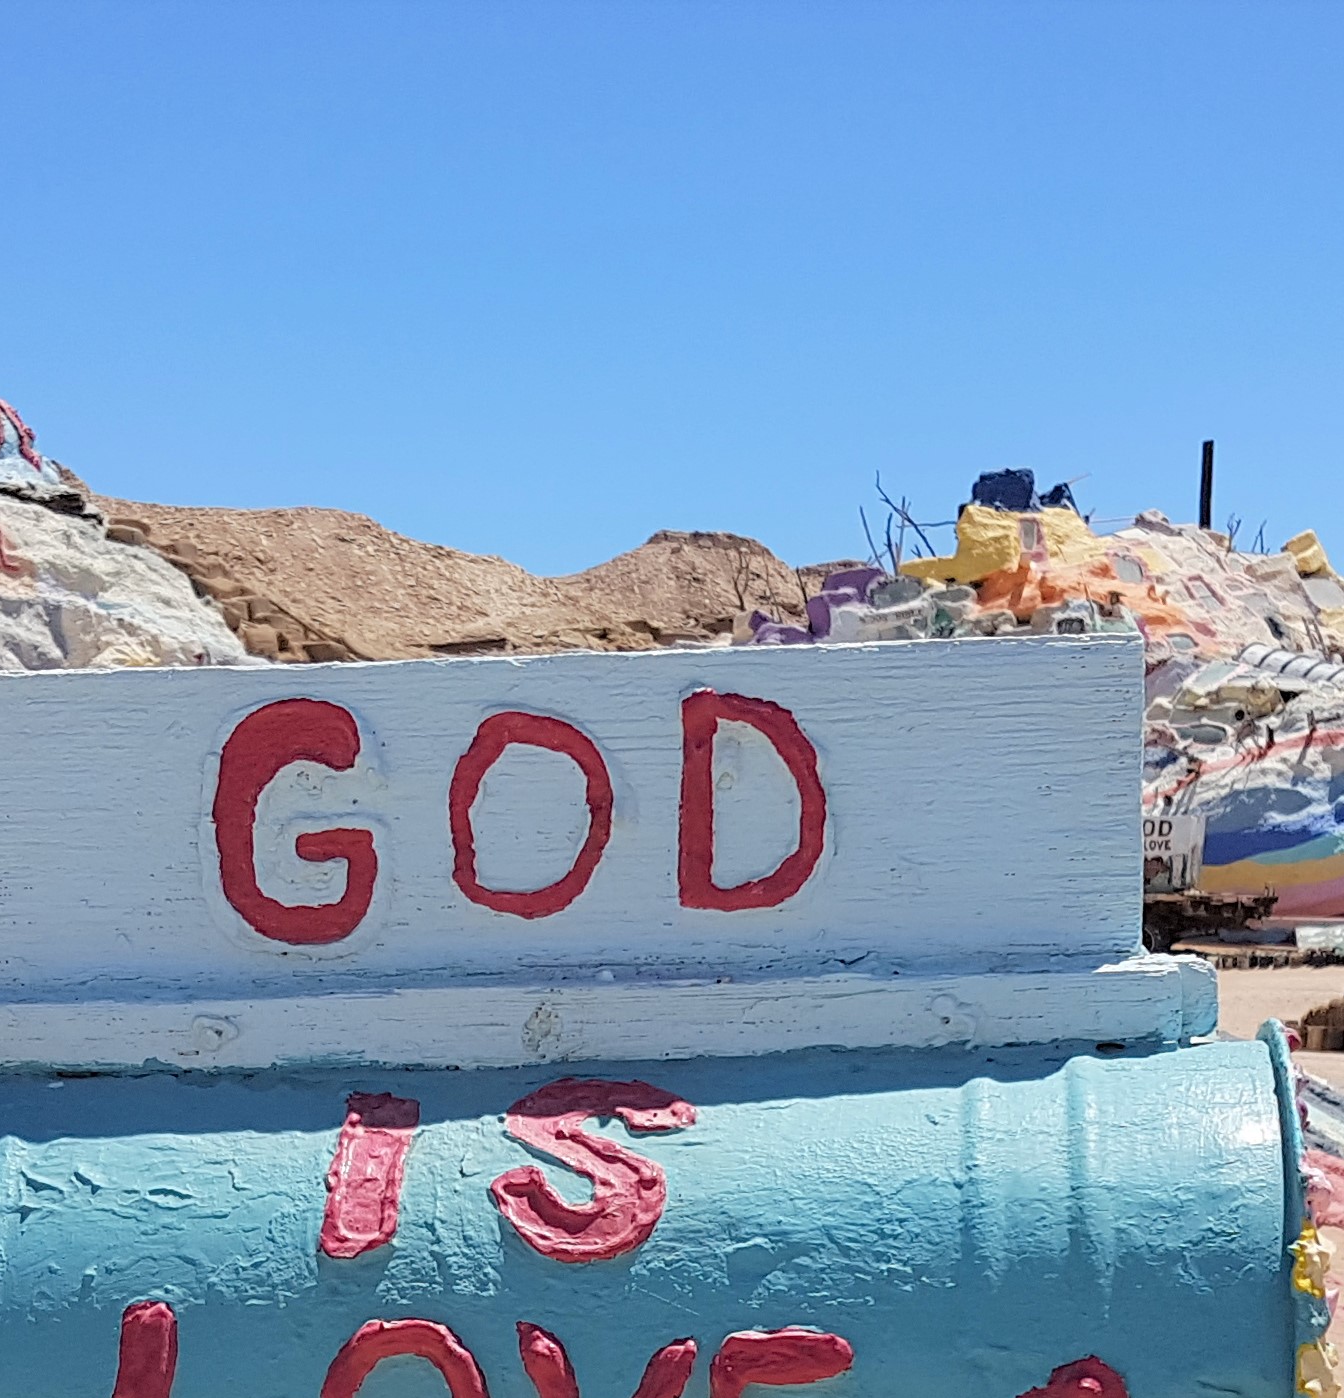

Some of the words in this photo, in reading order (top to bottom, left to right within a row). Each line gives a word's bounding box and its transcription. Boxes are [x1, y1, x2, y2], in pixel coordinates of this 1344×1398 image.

[212, 688, 827, 945] GOD
[1143, 819, 1172, 837] OD
[320, 1079, 698, 1262] IS
